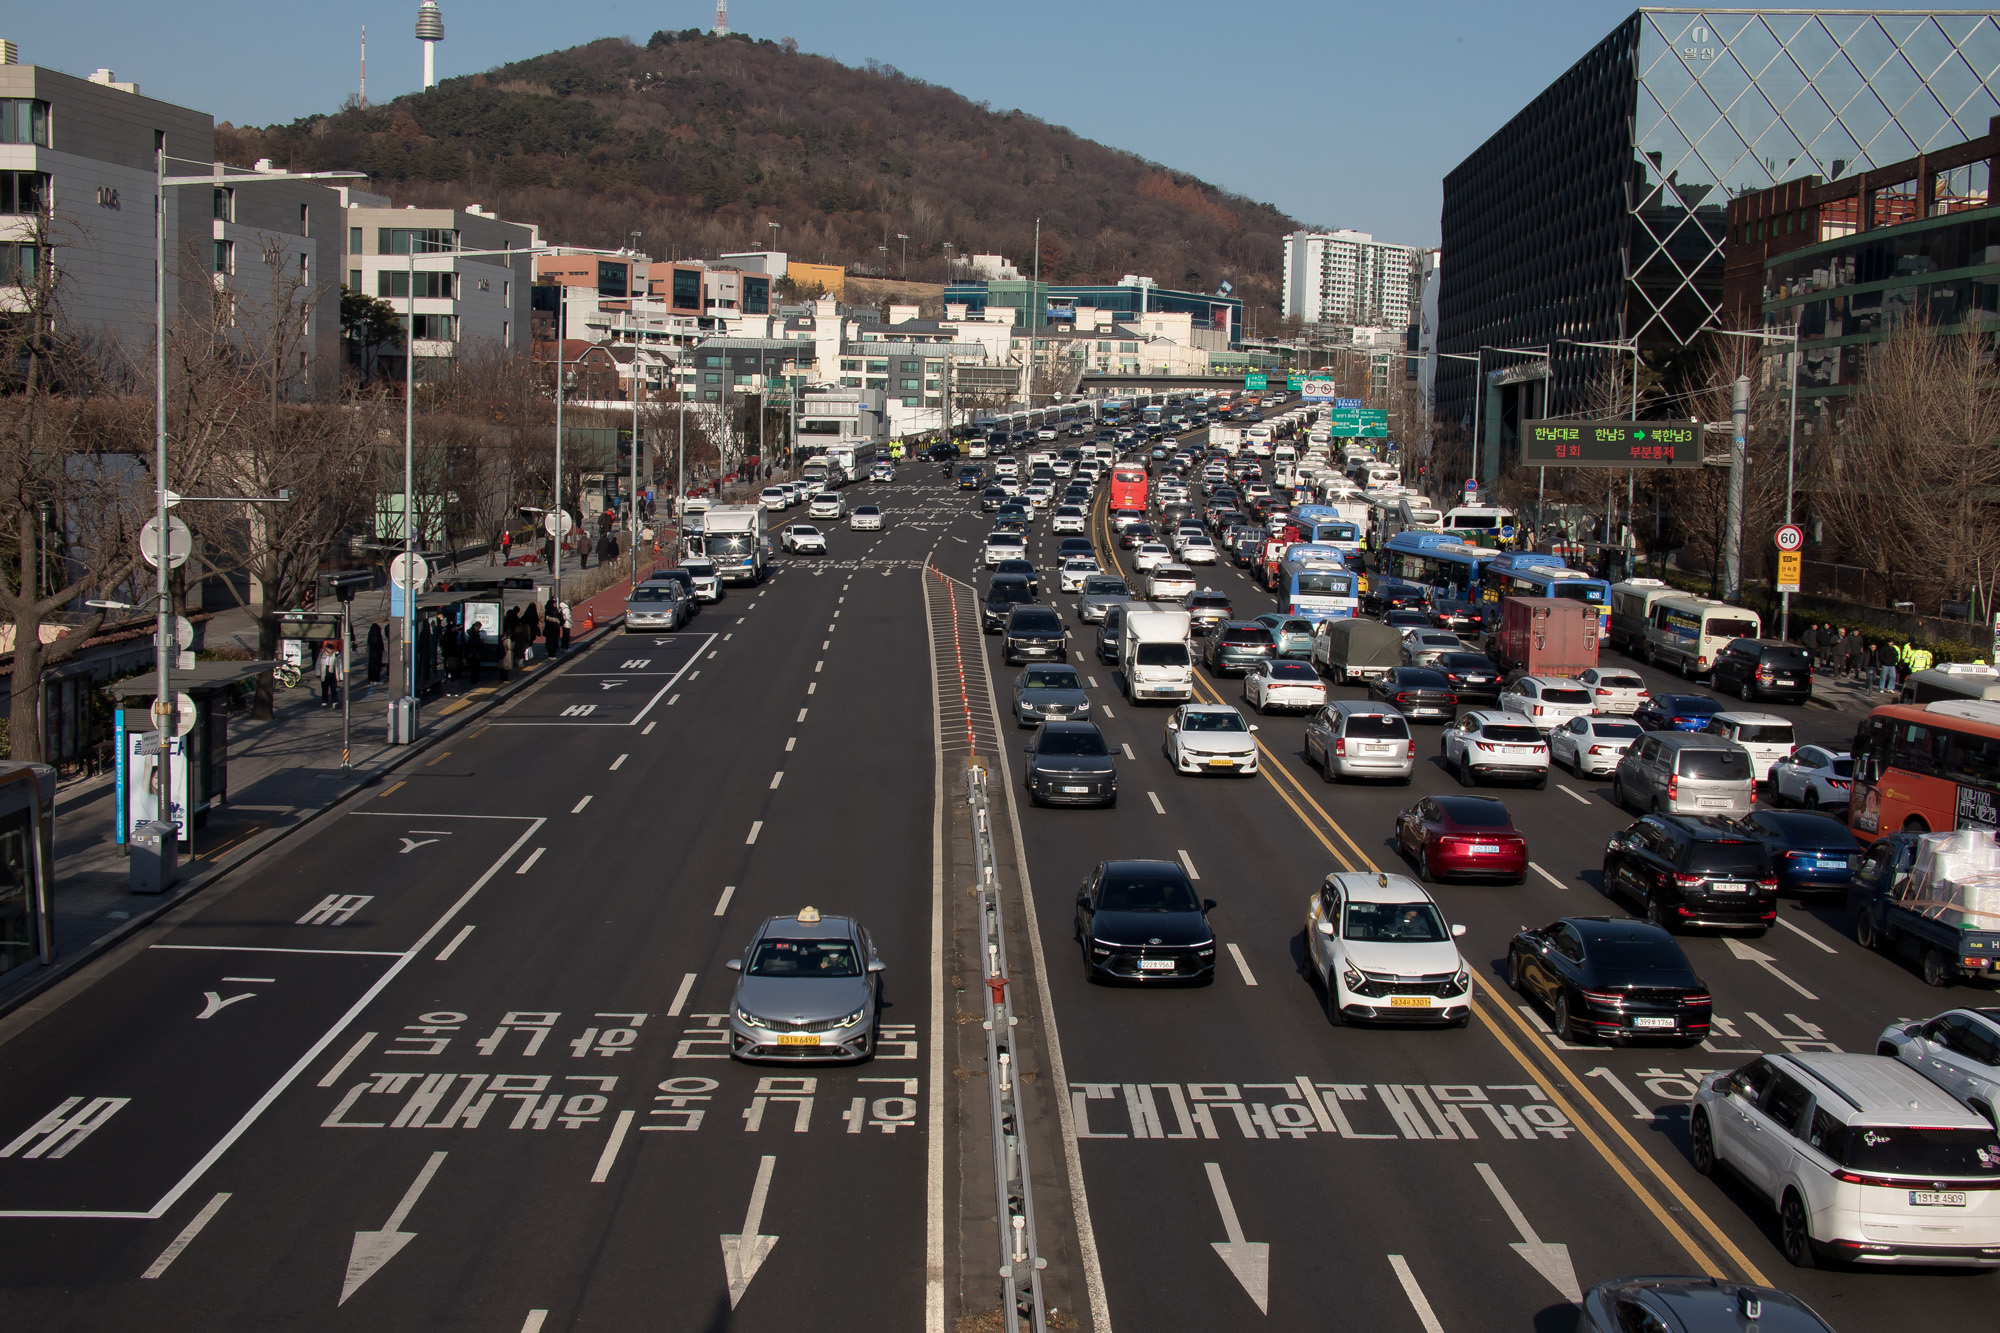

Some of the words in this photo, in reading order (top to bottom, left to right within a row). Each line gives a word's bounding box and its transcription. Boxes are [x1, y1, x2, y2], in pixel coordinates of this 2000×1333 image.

[1683, 47, 1715, 60] 일신
[1535, 428, 1580, 441] 한남대로
[1595, 429, 1625, 442] 한남5
[1651, 429, 1692, 443] 북한남3
[1629, 446, 1675, 459] 부분통제
[1781, 533, 1796, 544] 60
[1332, 583, 1346, 591] 470
[385, 1011, 649, 1058] 한남동
[799, 1036, 818, 1044] 6495
[320, 1072, 620, 1130] 한남대교
[640, 1076, 918, 1133] 한남동
[1069, 1083, 1318, 1140] 한남대교
[1316, 1083, 1576, 1140] 한남대교
[1942, 1194, 1963, 1204] 4509
